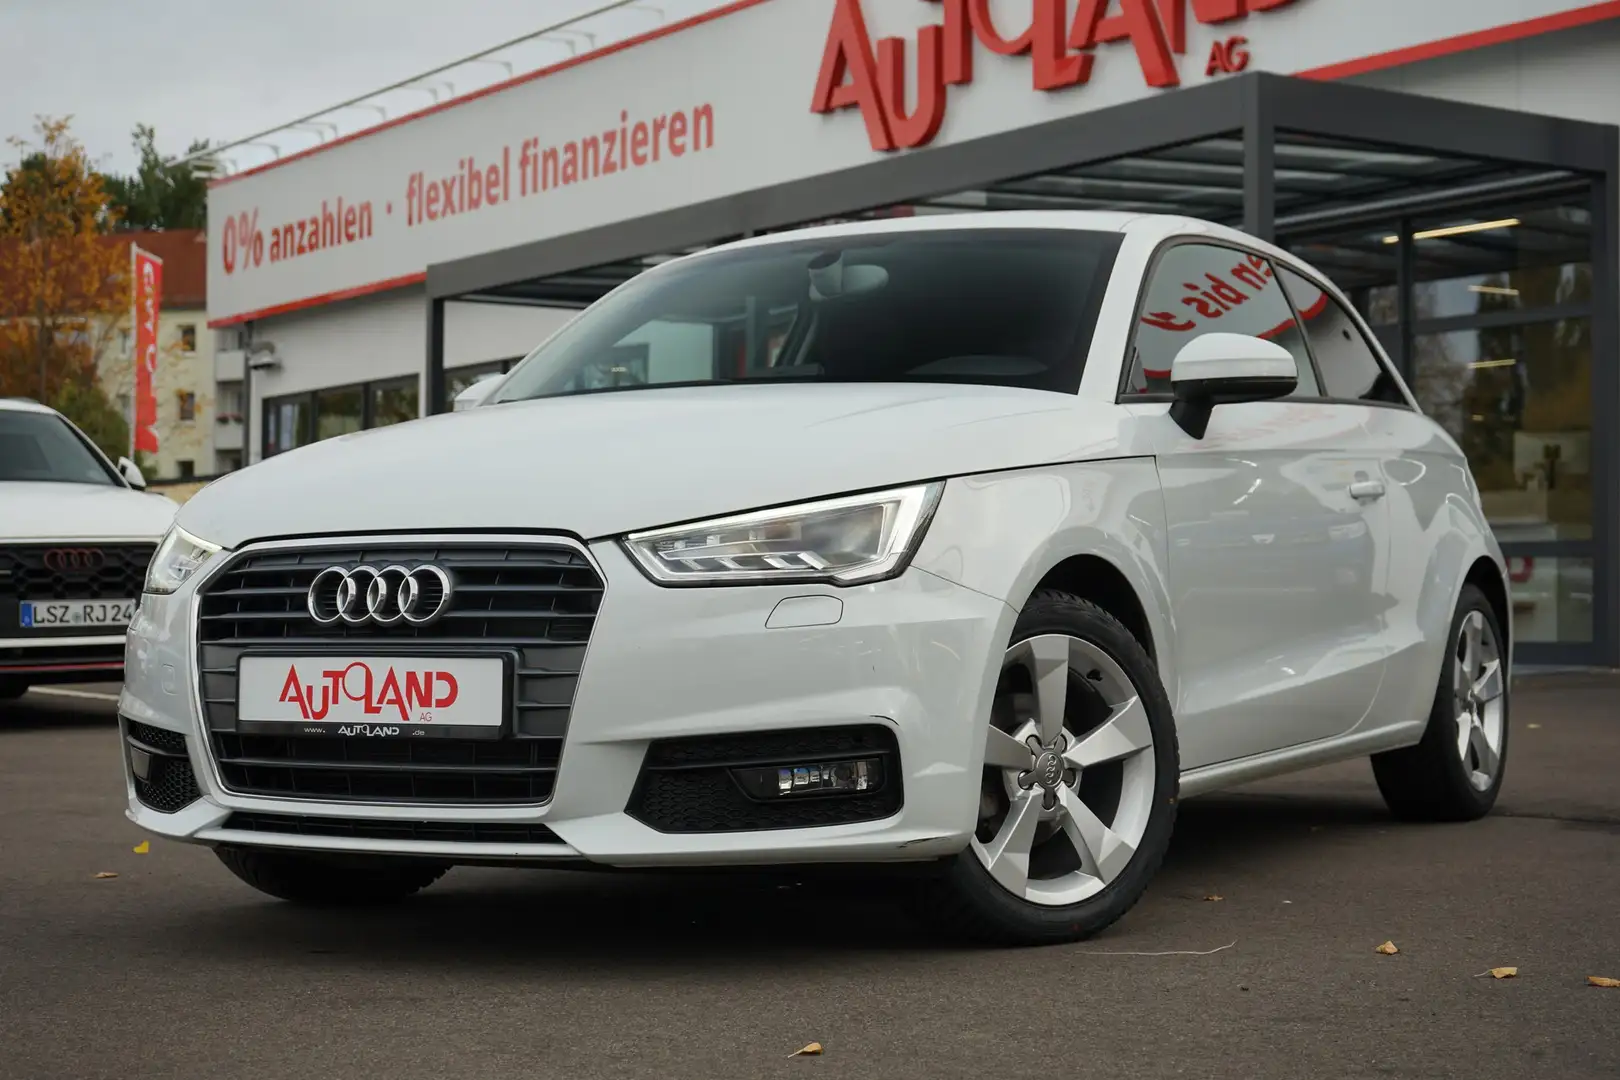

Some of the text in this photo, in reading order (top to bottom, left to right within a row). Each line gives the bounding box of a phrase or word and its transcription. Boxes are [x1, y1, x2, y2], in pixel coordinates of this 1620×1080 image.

[1204, 36, 1249, 75] AG
[811, 0, 1298, 151] AUTLA
[223, 102, 714, 275] 0% anzahlen flexibel finanzieren
[33, 604, 70, 624] LSZ
[279, 662, 458, 720] AUTOLAND
[338, 723, 400, 738] AUTOLAND
[419, 712, 433, 722] AG
